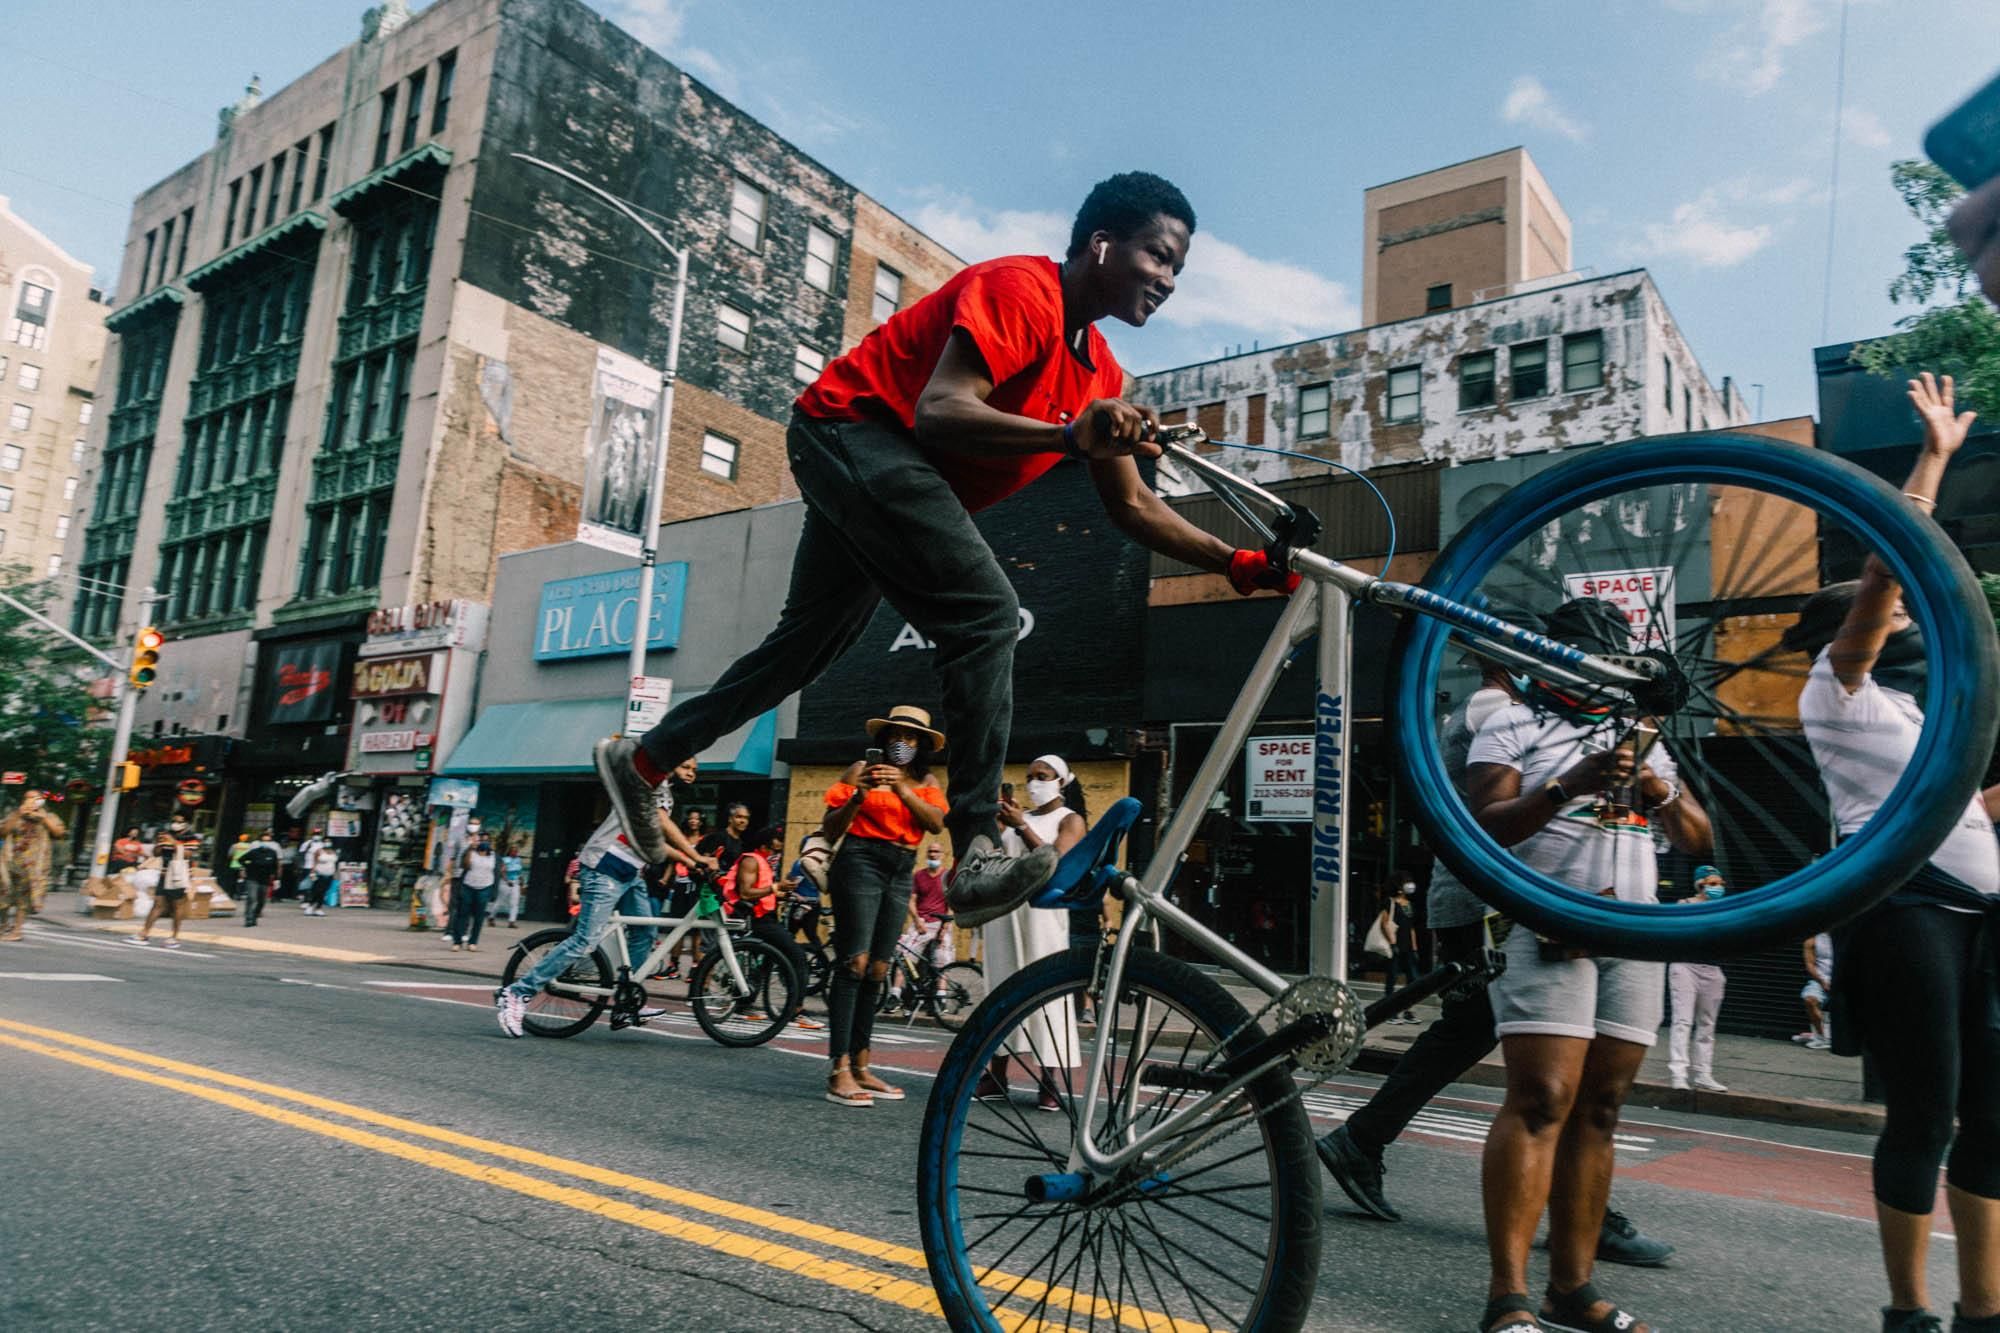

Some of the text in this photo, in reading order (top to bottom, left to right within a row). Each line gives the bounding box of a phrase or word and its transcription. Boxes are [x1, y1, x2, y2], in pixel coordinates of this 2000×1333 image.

[1583, 577, 1654, 595] SPACE
[540, 593, 666, 653] PLACE
[1259, 742, 1311, 756] SPACE
[1275, 759, 1294, 767] FOR
[1264, 770, 1306, 783] RENT
